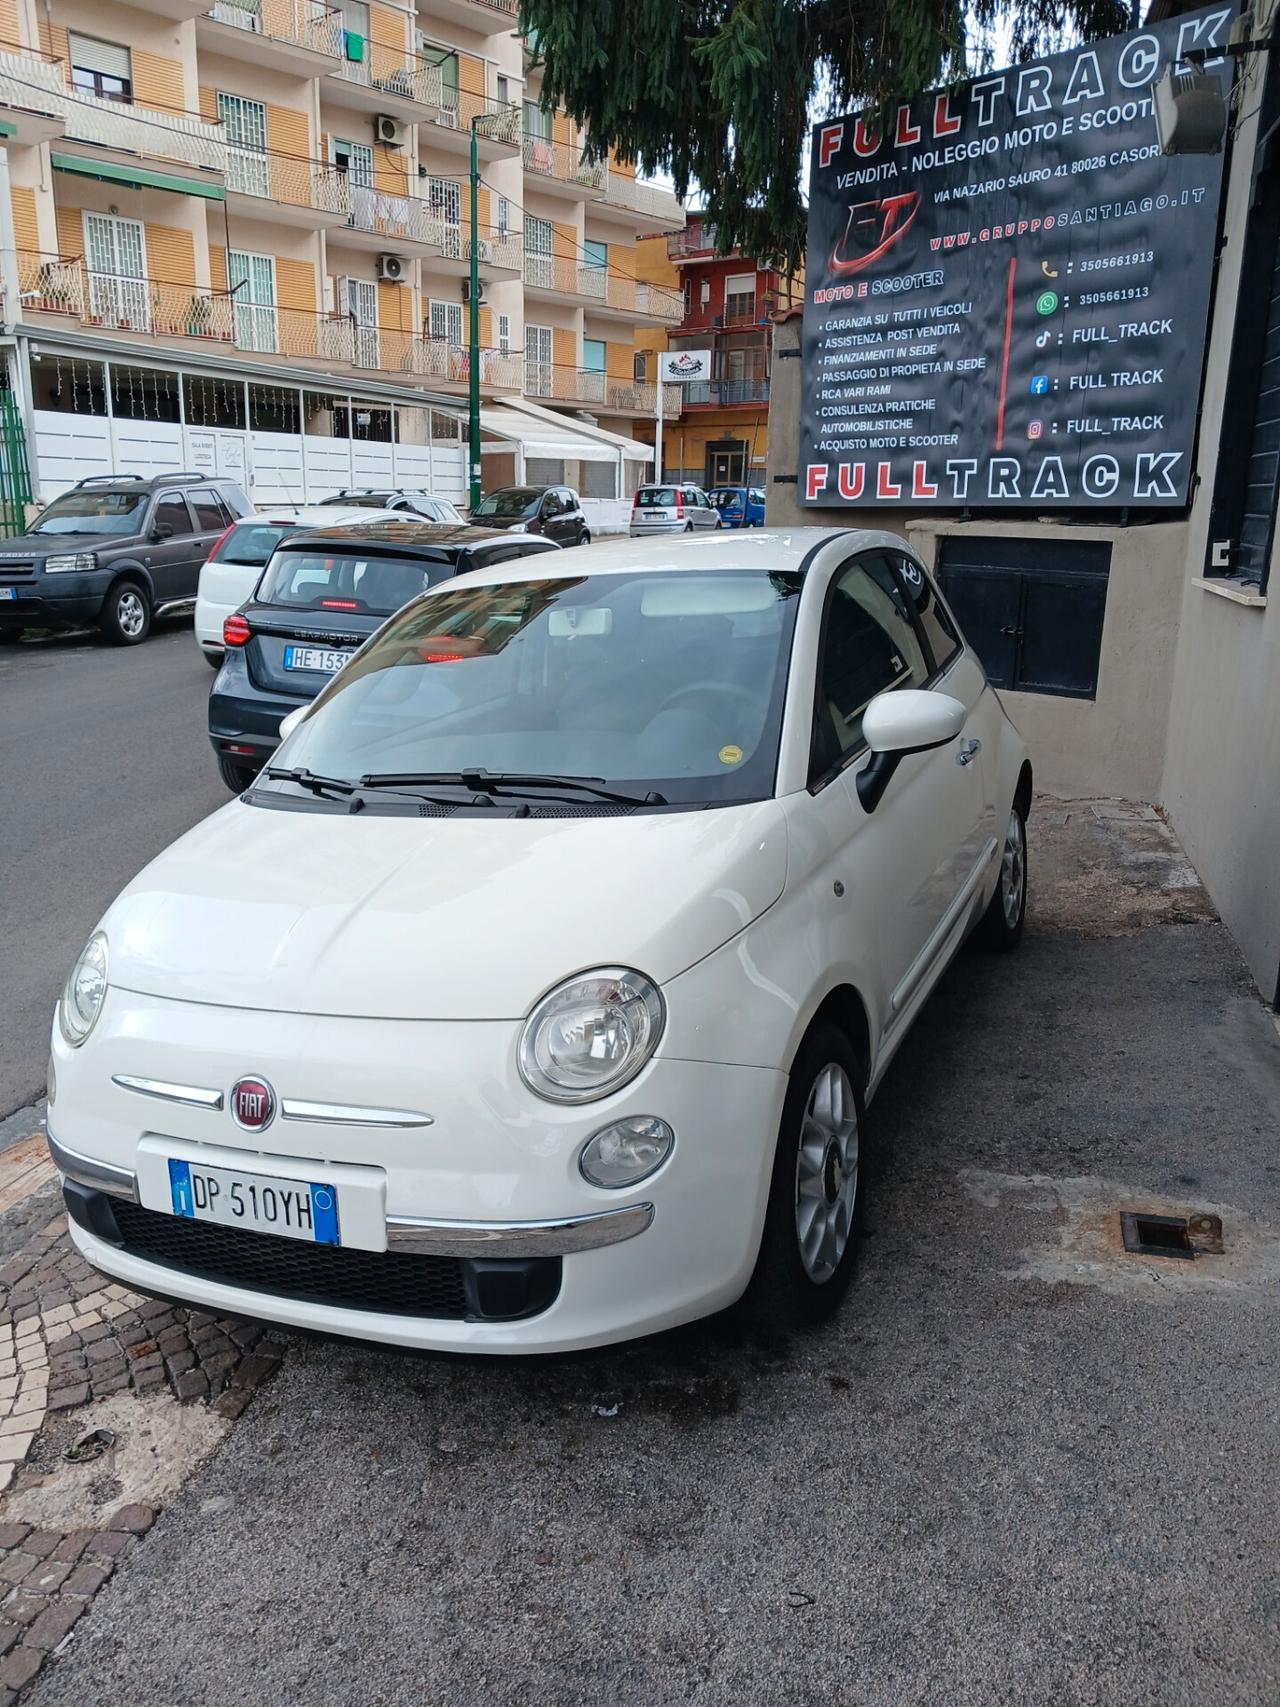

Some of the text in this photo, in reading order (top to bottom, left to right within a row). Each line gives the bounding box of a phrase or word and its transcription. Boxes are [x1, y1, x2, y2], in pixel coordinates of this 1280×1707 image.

[836, 161, 898, 190] VENDITA
[912, 136, 1000, 172] NOLEGGIO
[1004, 121, 1057, 150] MOTO
[1061, 116, 1074, 136] E
[1078, 98, 1156, 131] SCOOT
[934, 144, 1161, 203] VIA NAZARIO SAURO 41 80026 CASOR
[1080, 251, 1154, 272] 3505661913
[813, 270, 944, 304] MOTO E SCOOTER
[1079, 287, 1149, 305] 3505661913
[825, 302, 972, 331] GARANZIA SU TUTTI I VEICOLI
[824, 323, 961, 349] ASSISTENZA POST VENDITA
[823, 344, 937, 366] FINANZIAMENTI IN SEDE
[822, 357, 986, 383] PASSAGGIO DI PROPIETA IN SEDE
[1069, 374, 1107, 390] FULL
[1111, 369, 1164, 387] TRACK
[821, 384, 892, 400] RCA VARI RAMI
[821, 399, 936, 417] CONSULENZA PRATICHE
[820, 418, 914, 434] AUTOMOBILISTICHE
[819, 434, 959, 452] ACQUISTO MOTO E SCOOTER
[295, 629, 358, 642] LEAPMOTOR
[294, 649, 312, 667] HE
[239, 1092, 265, 1118] FIAT
[192, 1174, 220, 1212] DP
[231, 1182, 312, 1229] 510YH
